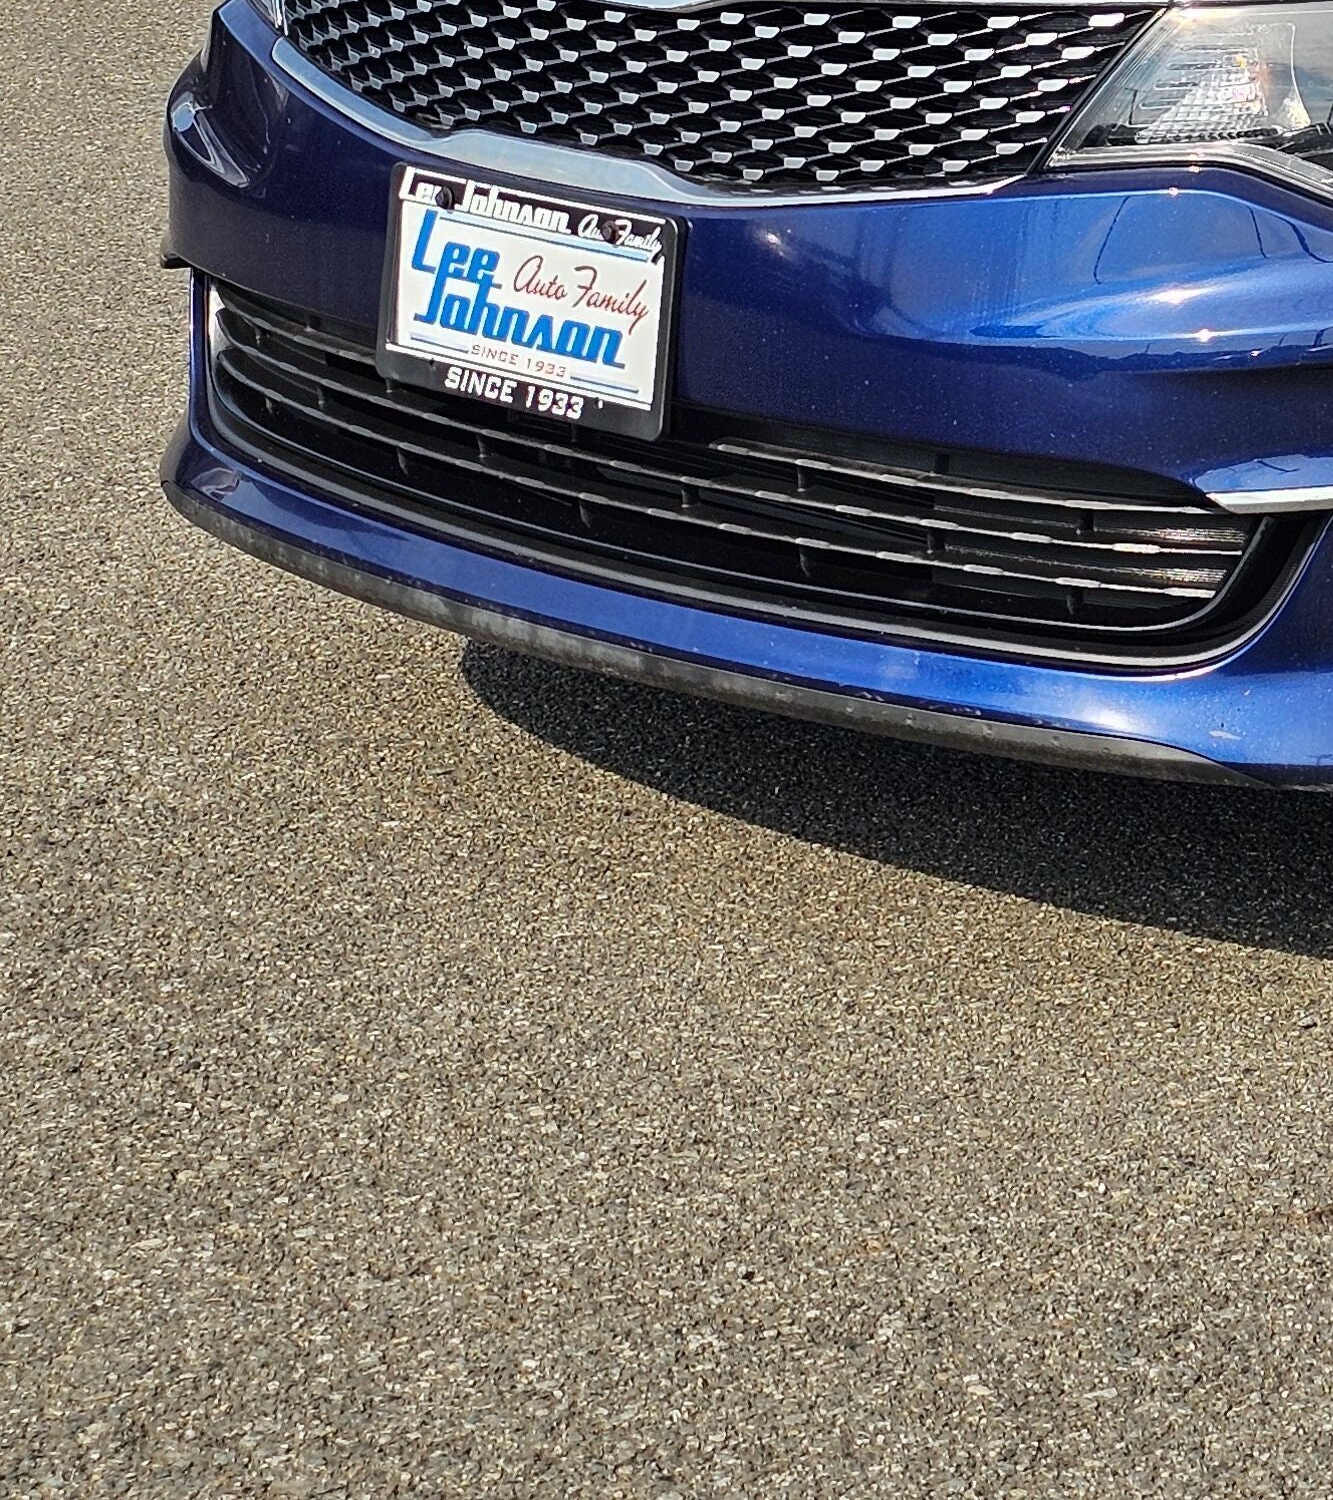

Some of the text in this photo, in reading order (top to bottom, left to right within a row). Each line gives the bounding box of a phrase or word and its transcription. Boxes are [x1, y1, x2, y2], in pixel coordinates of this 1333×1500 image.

[400, 166, 449, 204] Le
[455, 180, 572, 235] Johnson
[411, 208, 501, 279] Lee
[413, 271, 625, 368] Johnson
[513, 255, 649, 335] Auto Family
[444, 366, 584, 420] SINCE 1933
[470, 344, 567, 379] SINCE 1933
